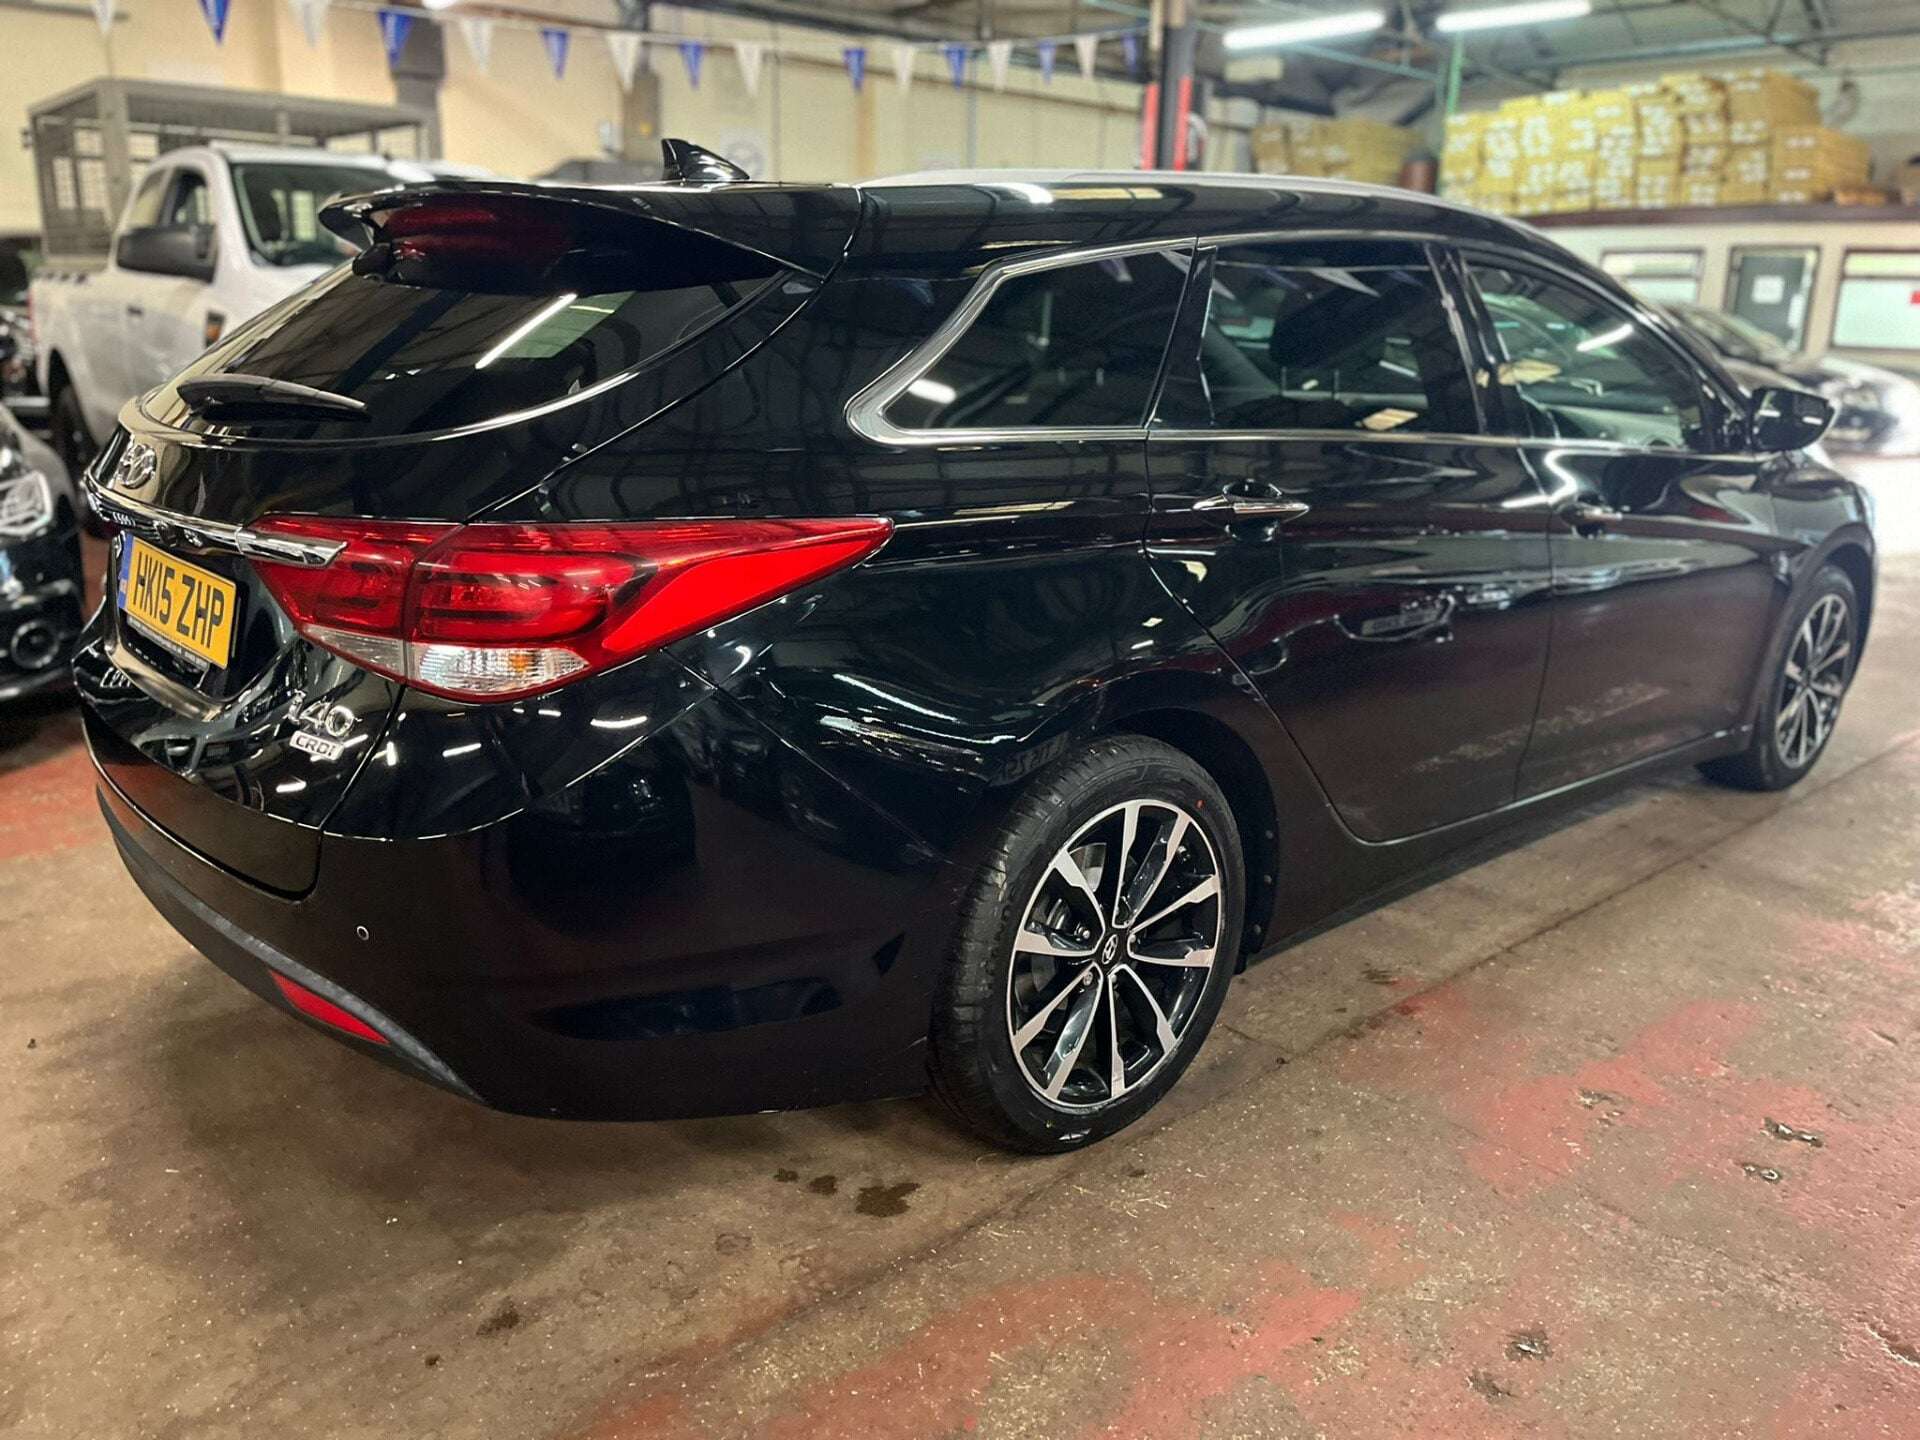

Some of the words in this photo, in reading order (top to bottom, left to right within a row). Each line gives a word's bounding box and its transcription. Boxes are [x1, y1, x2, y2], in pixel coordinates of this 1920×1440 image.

[133, 551, 175, 625] HK15
[177, 574, 224, 649] ZHP
[287, 689, 355, 737] i40
